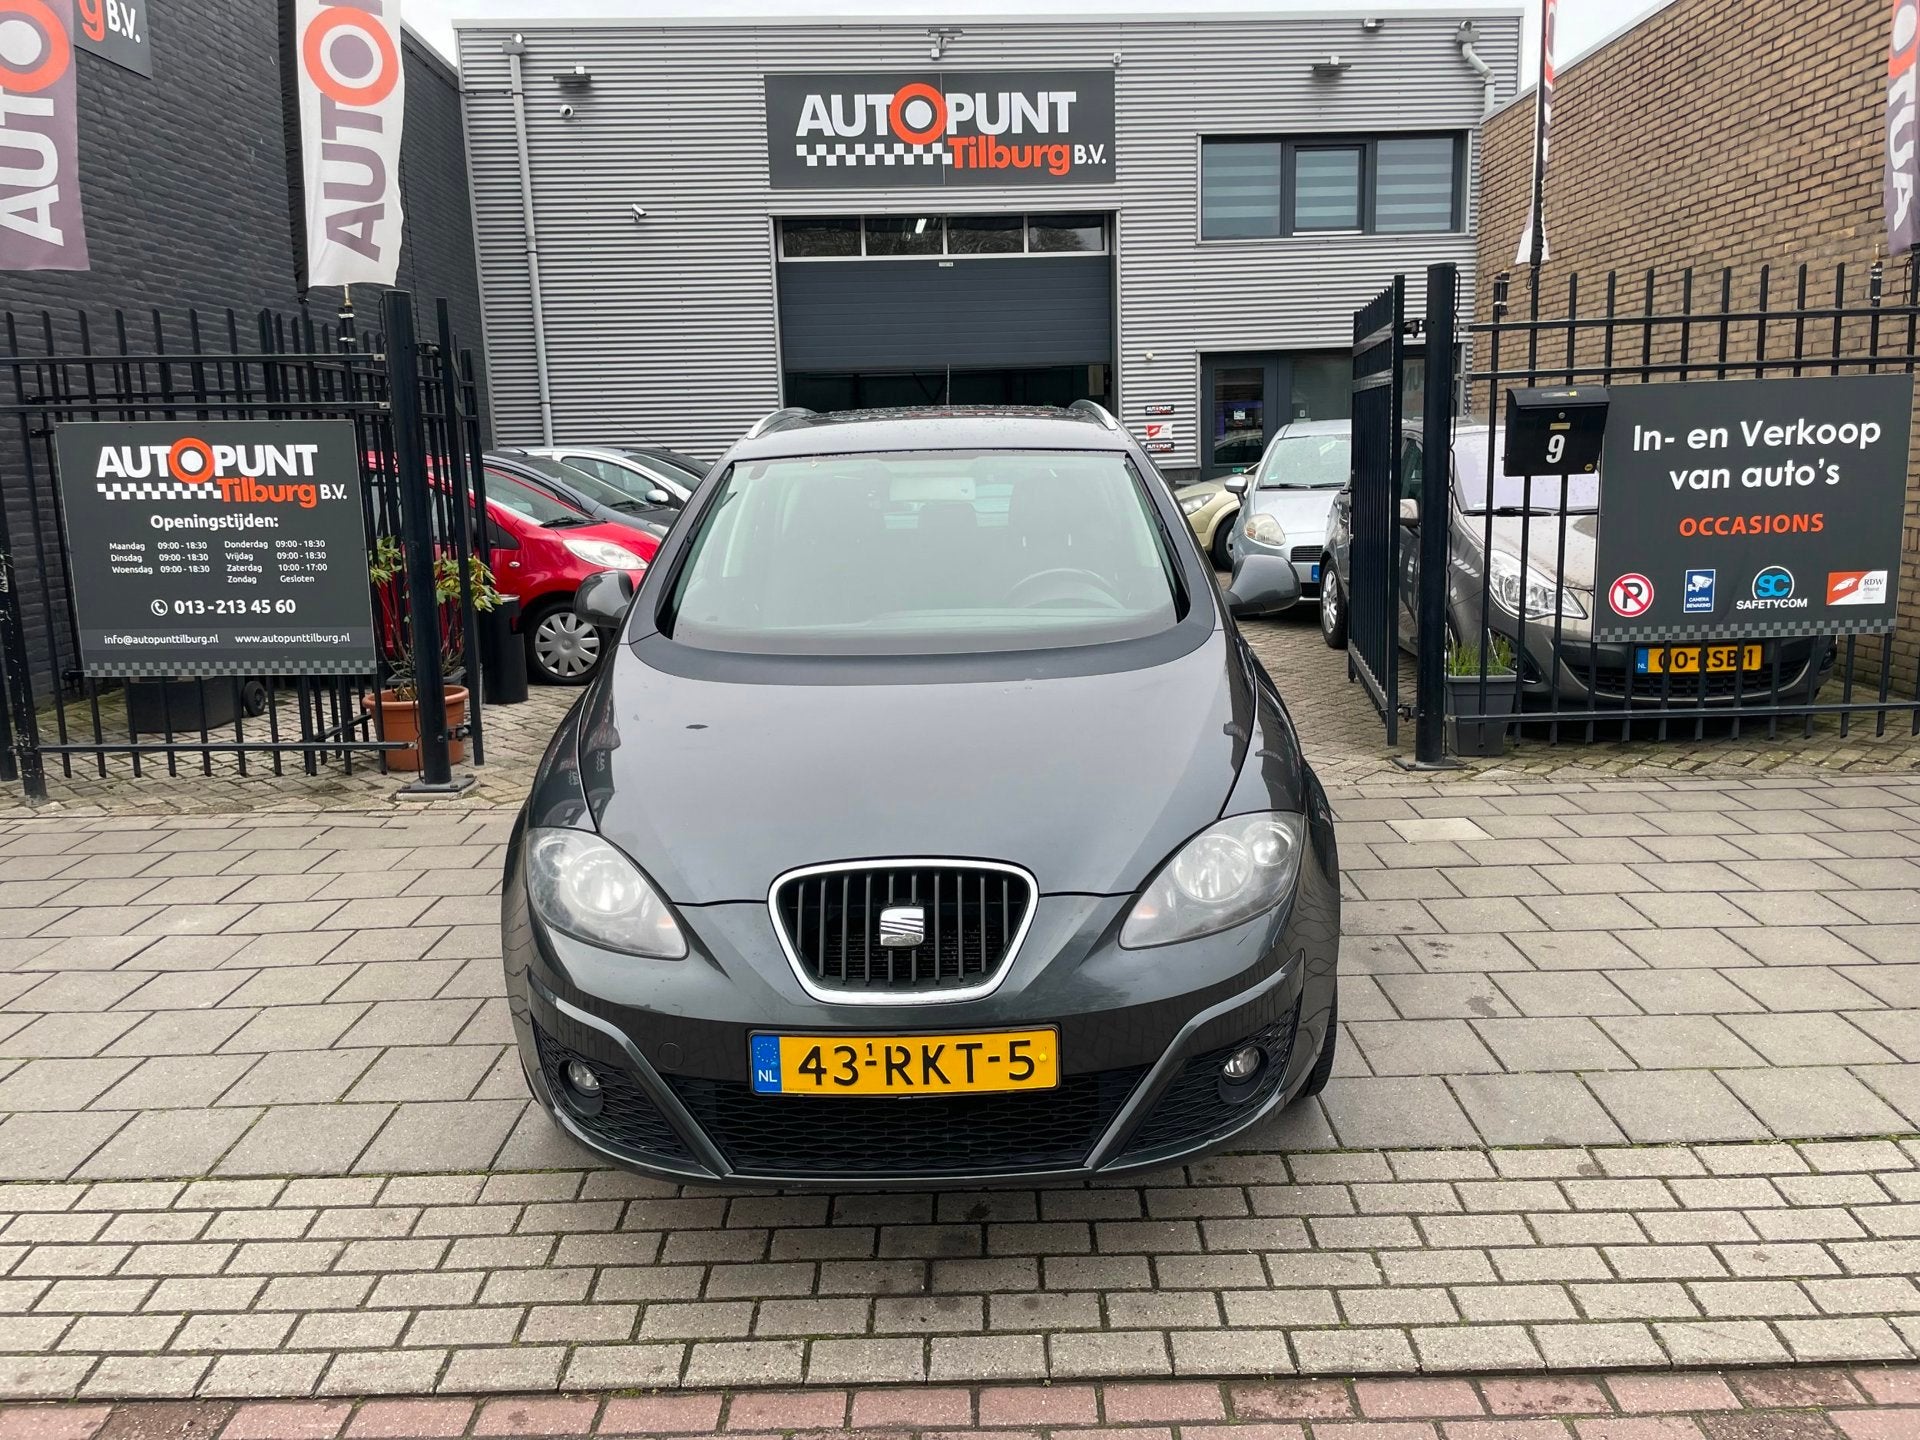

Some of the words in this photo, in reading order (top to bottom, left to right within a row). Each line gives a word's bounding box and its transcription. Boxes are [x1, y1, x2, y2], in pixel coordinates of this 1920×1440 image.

[106, 0, 141, 43] B.V.
[796, 83, 1077, 145] AUTOPUNT
[302, 0, 400, 262] AUTO
[947, 136, 1070, 175] Tilburg
[1074, 144, 1107, 165] B.V.
[1633, 425, 1675, 452] In-
[1687, 426, 1729, 450] en
[1740, 418, 1881, 450] Verkoop
[1546, 434, 1565, 464] 9
[96, 437, 318, 484] AUTOPUNT
[1669, 467, 1731, 490] van
[1741, 458, 1840, 488] auto's
[217, 477, 317, 508] Tilburg
[320, 484, 347, 500] B.V.
[151, 513, 279, 531] Openingstijden:
[1679, 513, 1824, 537] OCCASIONS
[109, 542, 145, 551] Maandag
[157, 541, 180, 550] 09:00
[186, 541, 207, 550] 18:30
[224, 540, 268, 549] Donderdag
[275, 539, 297, 548] 09:00
[304, 539, 325, 548] 18:30
[111, 554, 142, 563] Dinsdag
[159, 553, 181, 561] 09:00
[187, 553, 208, 561] 18:30
[225, 552, 253, 561] Vrijdag
[277, 551, 298, 559] 09:00
[305, 551, 327, 559] 18:30
[112, 565, 153, 574] Woensdag
[160, 565, 182, 573] 09:00
[188, 565, 210, 573] 18:30
[227, 564, 262, 573] Zaterdag
[278, 563, 299, 571] 10:00
[306, 563, 328, 571] 17:00
[227, 575, 257, 584] Zondag
[280, 574, 315, 583] Gesloten
[1757, 574, 1790, 597] SC
[1864, 578, 1884, 586] RDW
[251, 600, 271, 614] 45
[275, 599, 296, 613] 60
[1736, 597, 1808, 611] SAFETYCOM
[104, 634, 219, 646] info@autopunttilburg.nl
[235, 633, 351, 645] www.autopunttilburg.nl
[758, 1070, 778, 1083] NL
